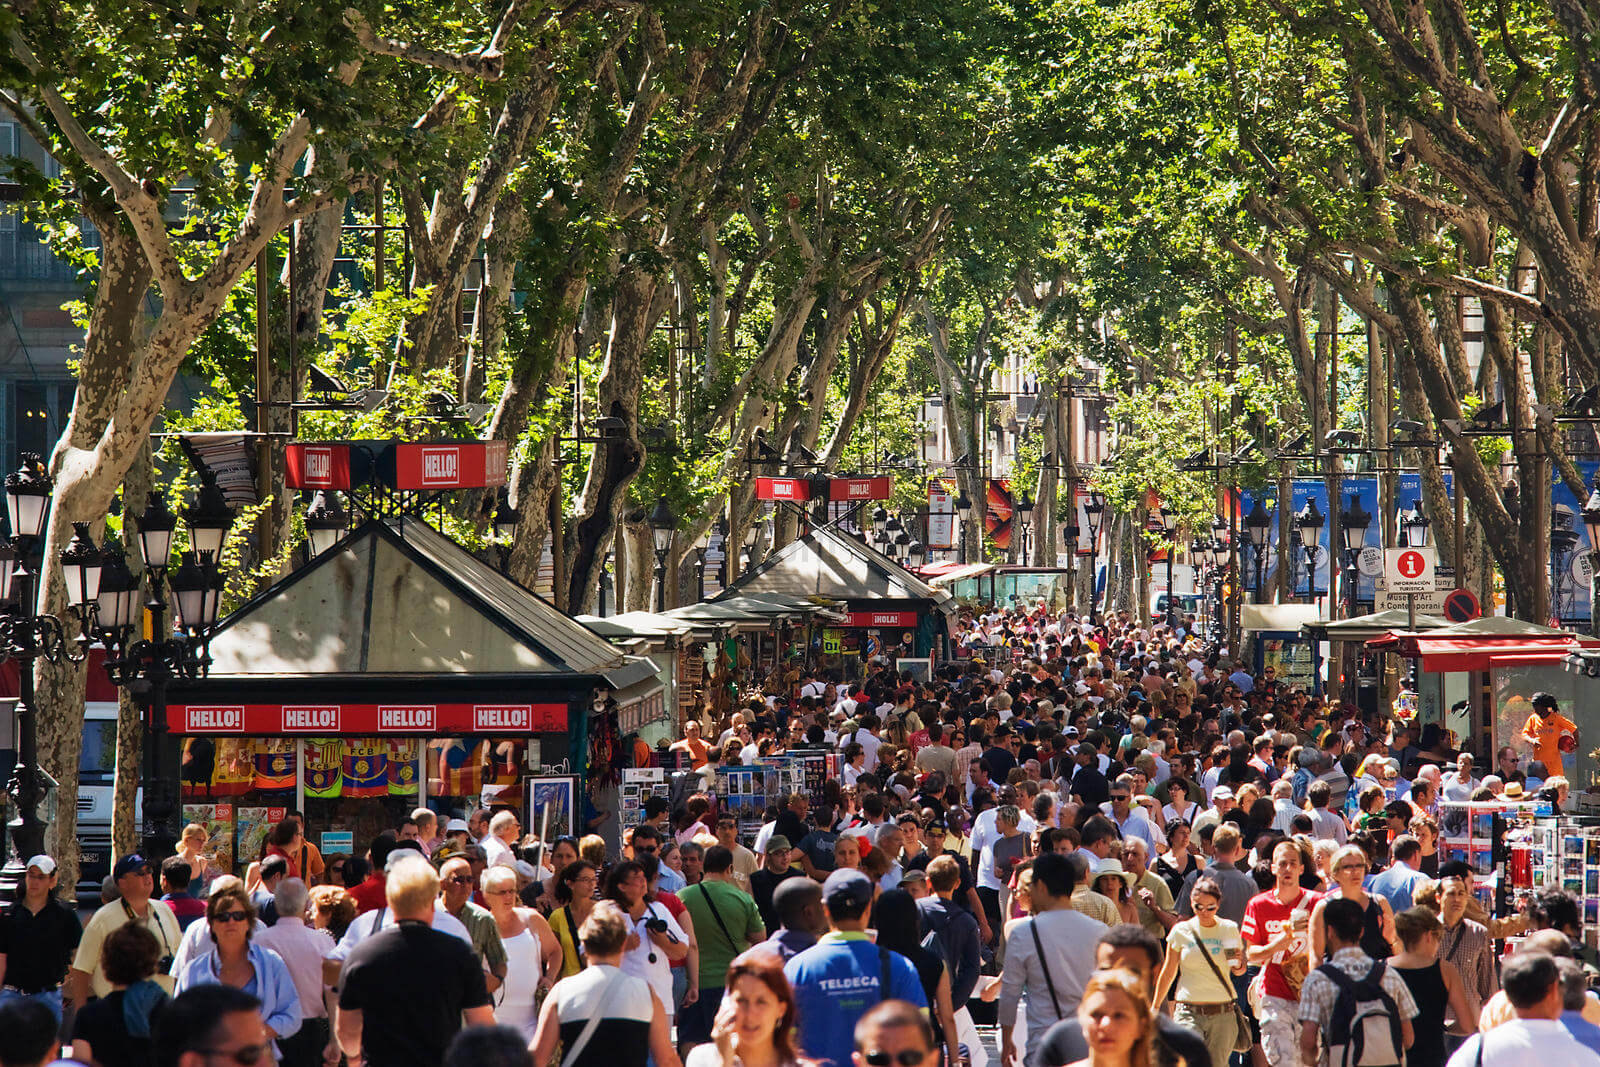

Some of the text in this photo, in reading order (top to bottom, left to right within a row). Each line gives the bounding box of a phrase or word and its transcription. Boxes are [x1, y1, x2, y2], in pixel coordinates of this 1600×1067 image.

[306, 453, 330, 477] HELLO!
[424, 454, 457, 478] HELLO!
[1434, 579, 1451, 587] tuny
[1387, 593, 1409, 601] Muse
[1387, 602, 1440, 611] Conteporani
[189, 710, 240, 727] HELLO!
[286, 710, 336, 727] HELLO!
[382, 709, 432, 727] HELLO!
[477, 709, 528, 726] HELLO!
[819, 976, 880, 990] TELDECA
